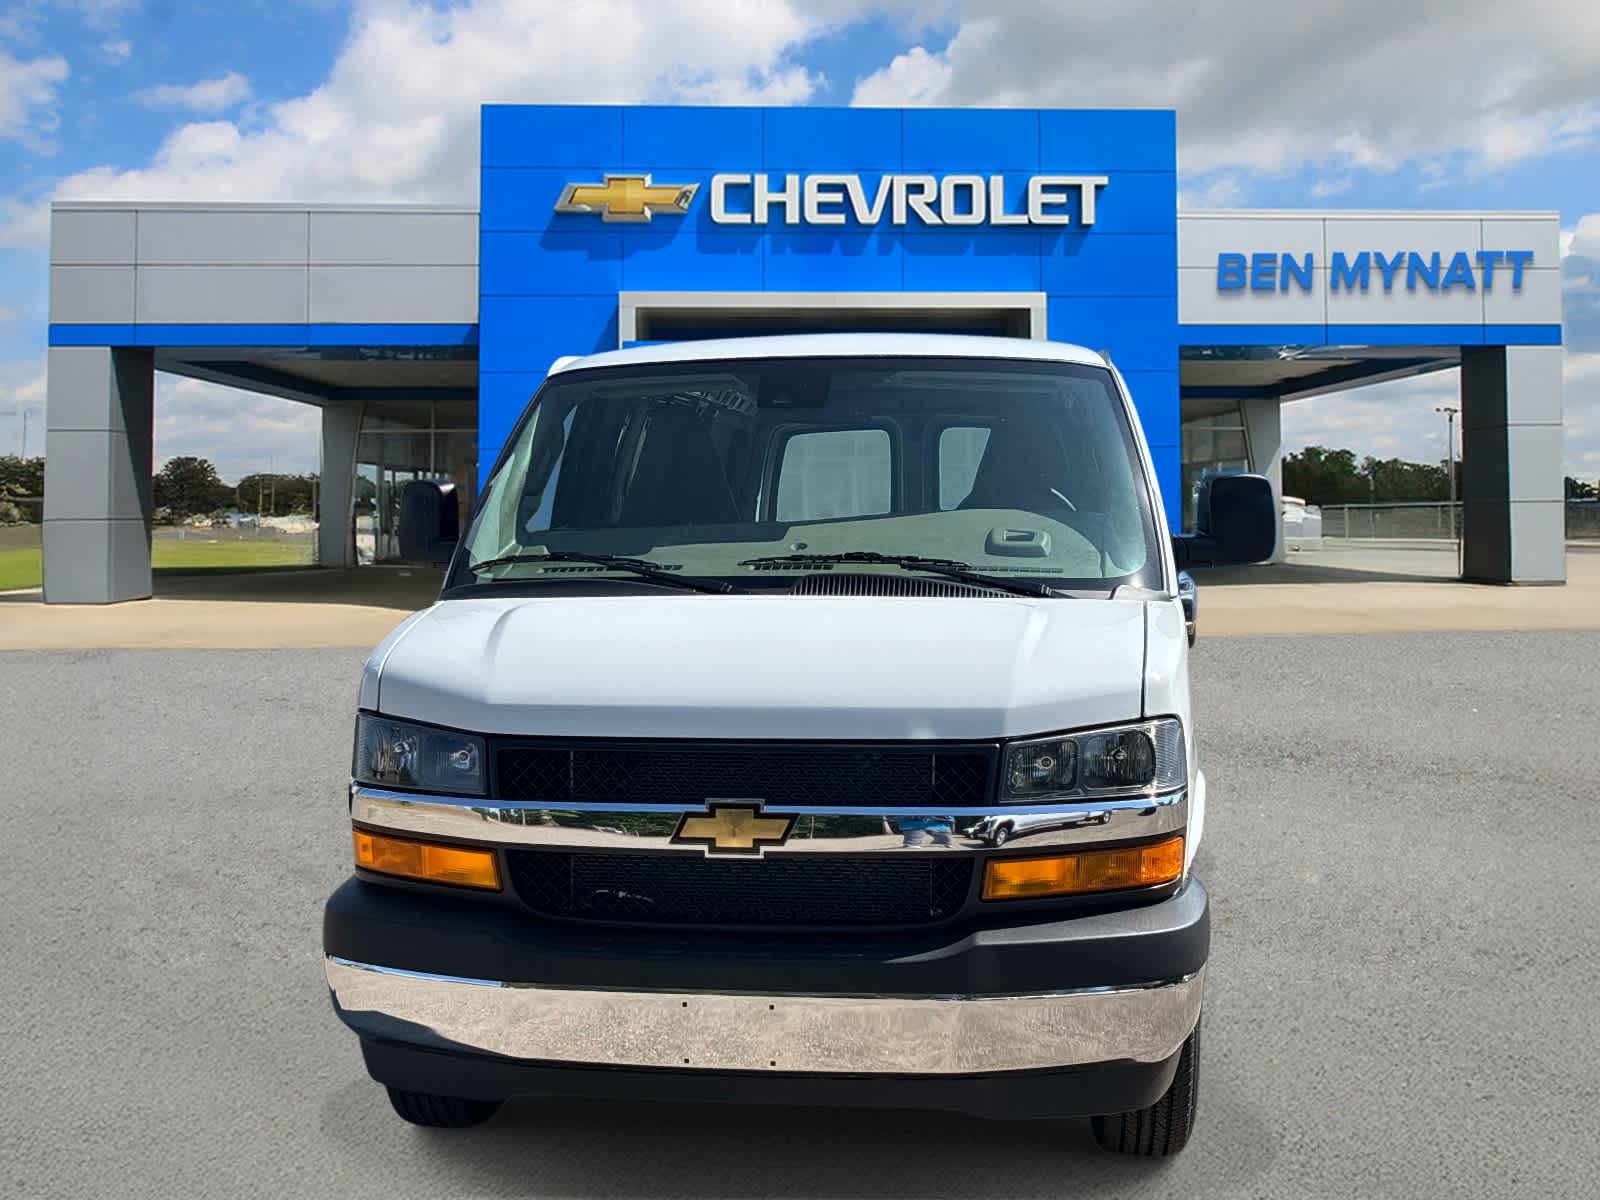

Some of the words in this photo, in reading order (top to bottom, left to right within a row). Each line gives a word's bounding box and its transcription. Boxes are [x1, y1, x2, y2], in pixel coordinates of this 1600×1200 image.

[709, 173, 1110, 226] CHEVROLET
[1217, 252, 1314, 291] BEN
[1330, 250, 1534, 291] MYNATT
